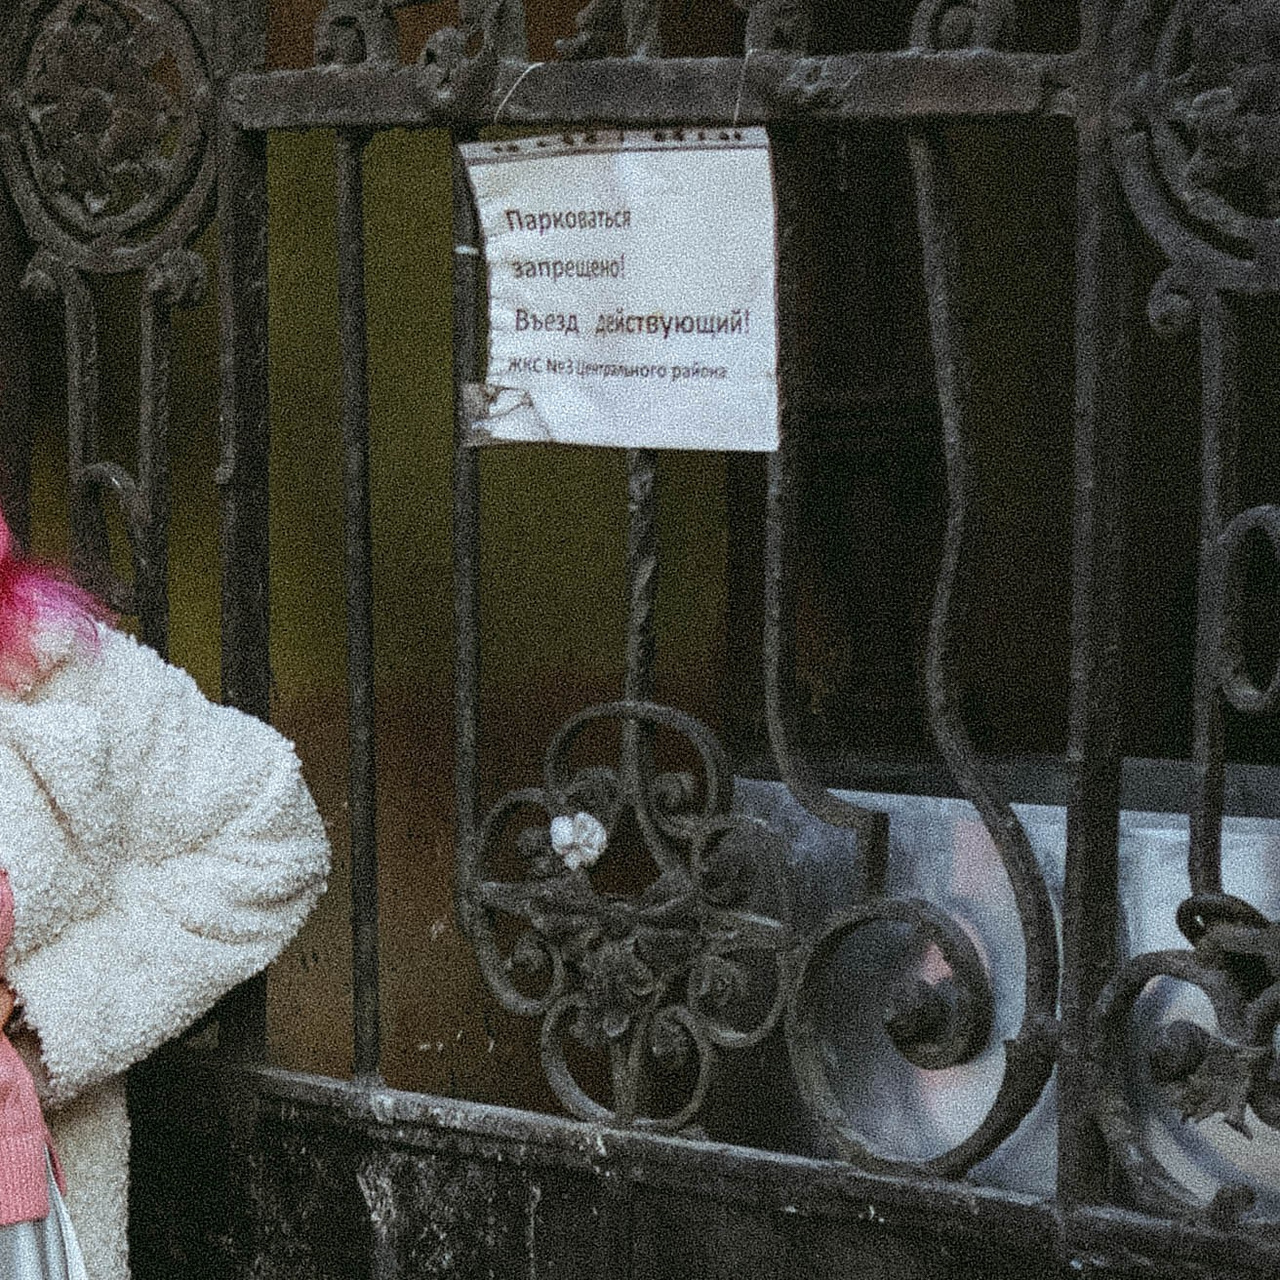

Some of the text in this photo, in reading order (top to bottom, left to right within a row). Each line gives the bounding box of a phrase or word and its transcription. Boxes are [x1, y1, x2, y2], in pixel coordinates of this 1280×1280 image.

[504, 208, 631, 236] Парковаться
[511, 252, 625, 281] запрещено!
[515, 308, 750, 339] Въезд действующий!
[671, 363, 727, 381] района
